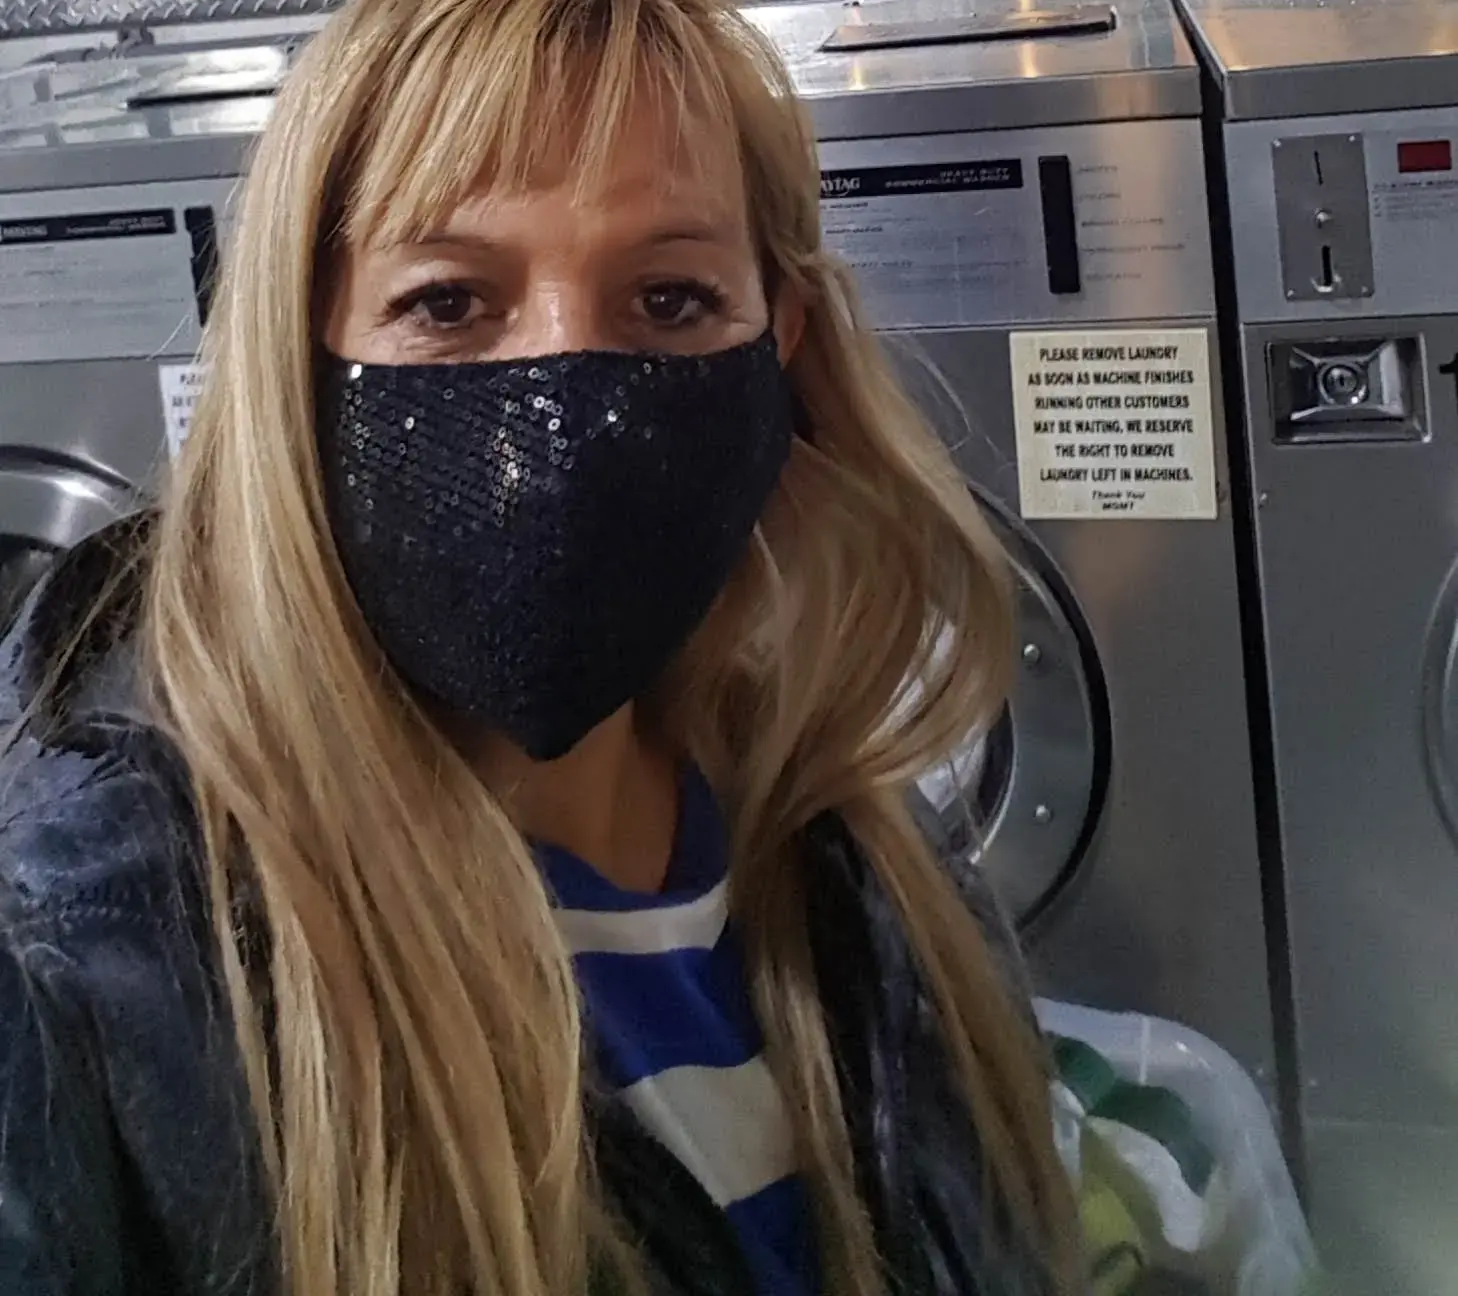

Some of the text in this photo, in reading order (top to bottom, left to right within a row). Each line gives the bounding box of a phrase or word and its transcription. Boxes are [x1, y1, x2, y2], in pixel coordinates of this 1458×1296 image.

[1039, 345, 1178, 361] PLEASE REMOVE LAUNDRY
[1028, 370, 1194, 386] AS SOON AS MACHINE FINISHES
[1034, 395, 1190, 410] RUNNING OTHER CUSTOMERS
[1034, 420, 1055, 434] MAY
[1059, 420, 1072, 434] BE
[1126, 420, 1142, 433] WE
[1145, 419, 1194, 433] RESERVE
[1055, 443, 1175, 457] THE RIGHT TO REMOVE
[1040, 468, 1194, 482] LAUNDRY LEFT IN MACHINES.
[1092, 490, 1146, 500] Thank You
